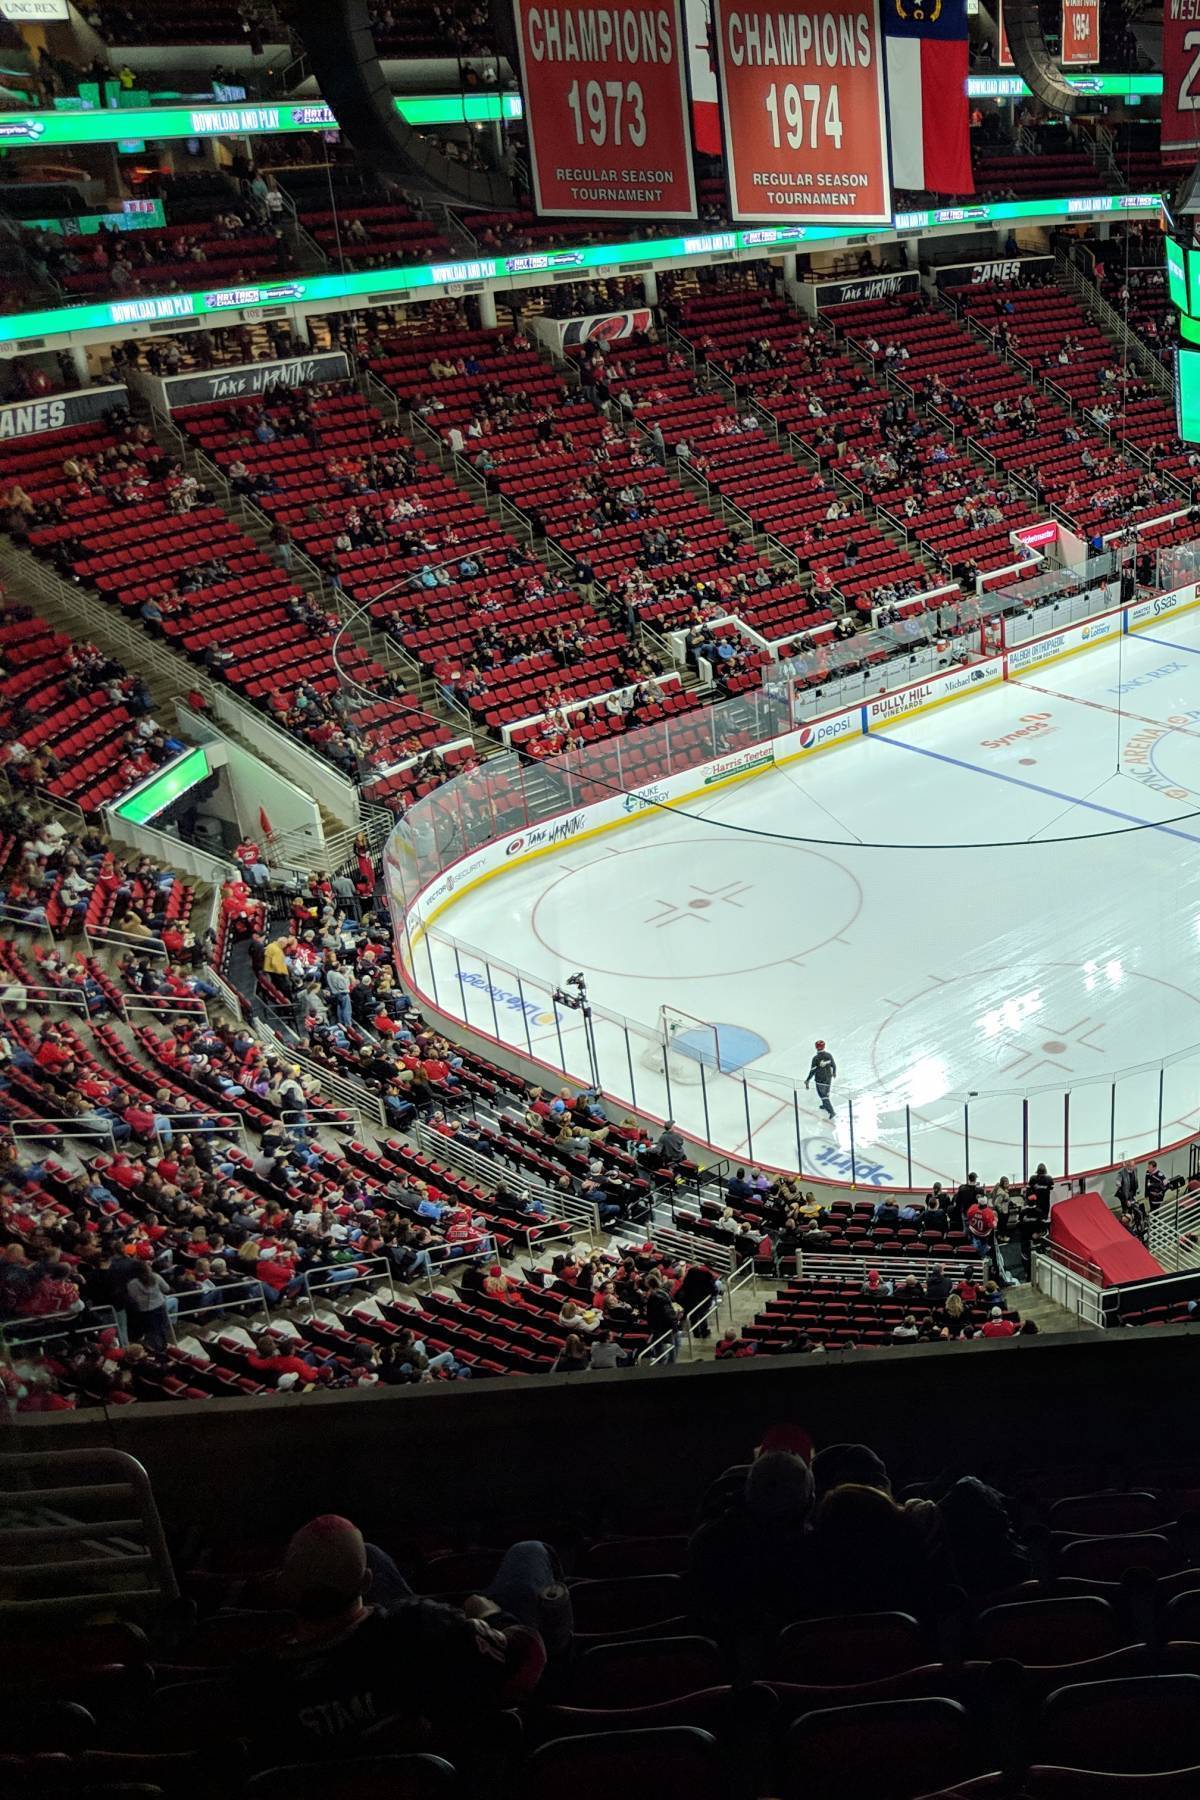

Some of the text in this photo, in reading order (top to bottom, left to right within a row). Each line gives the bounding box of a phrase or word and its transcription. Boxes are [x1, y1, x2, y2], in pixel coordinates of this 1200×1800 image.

[528, 6, 672, 64] CHAMPIONS
[728, 12, 871, 67] CHAMPIONS
[192, 109, 279, 131] DOWNLOAD AND PLAY
[568, 80, 646, 147] 1973
[766, 83, 842, 150] 1974
[556, 168, 673, 183] REGULAR SEASON
[753, 173, 868, 187] REGULAR SEASON
[571, 188, 662, 202] TOURNAMENT
[767, 192, 856, 205] TOURNAMENT
[971, 261, 1021, 284] CANES
[840, 277, 903, 300] TAKE WARNING
[112, 296, 194, 322] DOWNLOAD AND PLAY
[209, 362, 320, 399] TAKE WARNING
[0, 401, 66, 437] ANES
[1160, 595, 1177, 611] sas
[1009, 635, 1065, 664] RALEIGH ORTHOPAEDIC
[944, 667, 998, 693] Michael Son
[1108, 661, 1189, 695] UNC REX
[872, 685, 933, 716] BULLY HILL
[883, 699, 923, 719] VINEYARDS
[817, 716, 851, 743] pepsi
[980, 721, 1049, 750] Syneos
[712, 757, 742, 775] Harris
[745, 748, 773, 763] Teeter
[1123, 727, 1165, 792] PNC ARENA
[638, 785, 658, 799] DUKE
[639, 791, 670, 810] ENERGY
[526, 814, 587, 847] TAKE WARNING
[426, 858, 486, 905] VECTOR SECURITY
